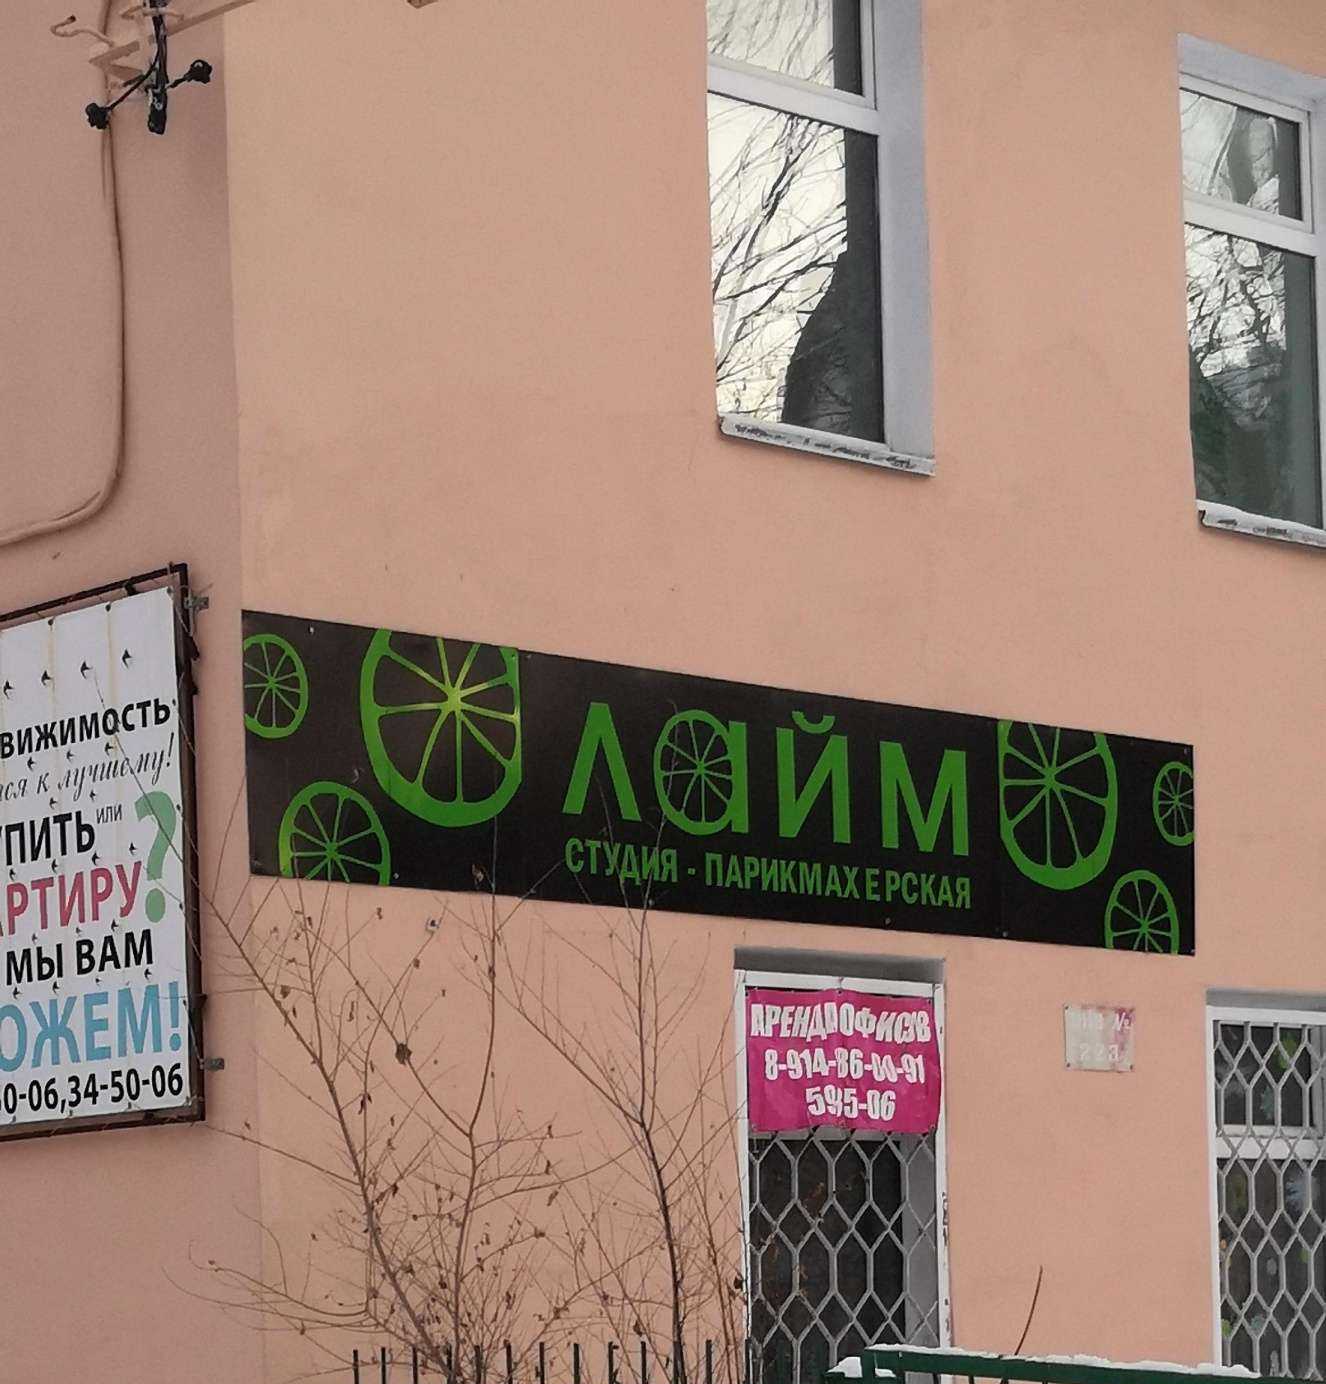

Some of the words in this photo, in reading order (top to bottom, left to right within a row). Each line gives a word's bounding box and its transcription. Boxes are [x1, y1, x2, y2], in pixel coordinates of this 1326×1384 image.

[0, 778, 28, 801] ся
[0, 810, 96, 866] ПИТЬ
[564, 837, 678, 886] СТУДИЯ
[0, 861, 142, 936] РТИРУ
[6, 943, 64, 986] МЫ
[75, 928, 154, 976] ВАМ
[0, 981, 182, 1073] ОЖЕМ!
[0, 1062, 184, 1114] 0-06,34-50-06
